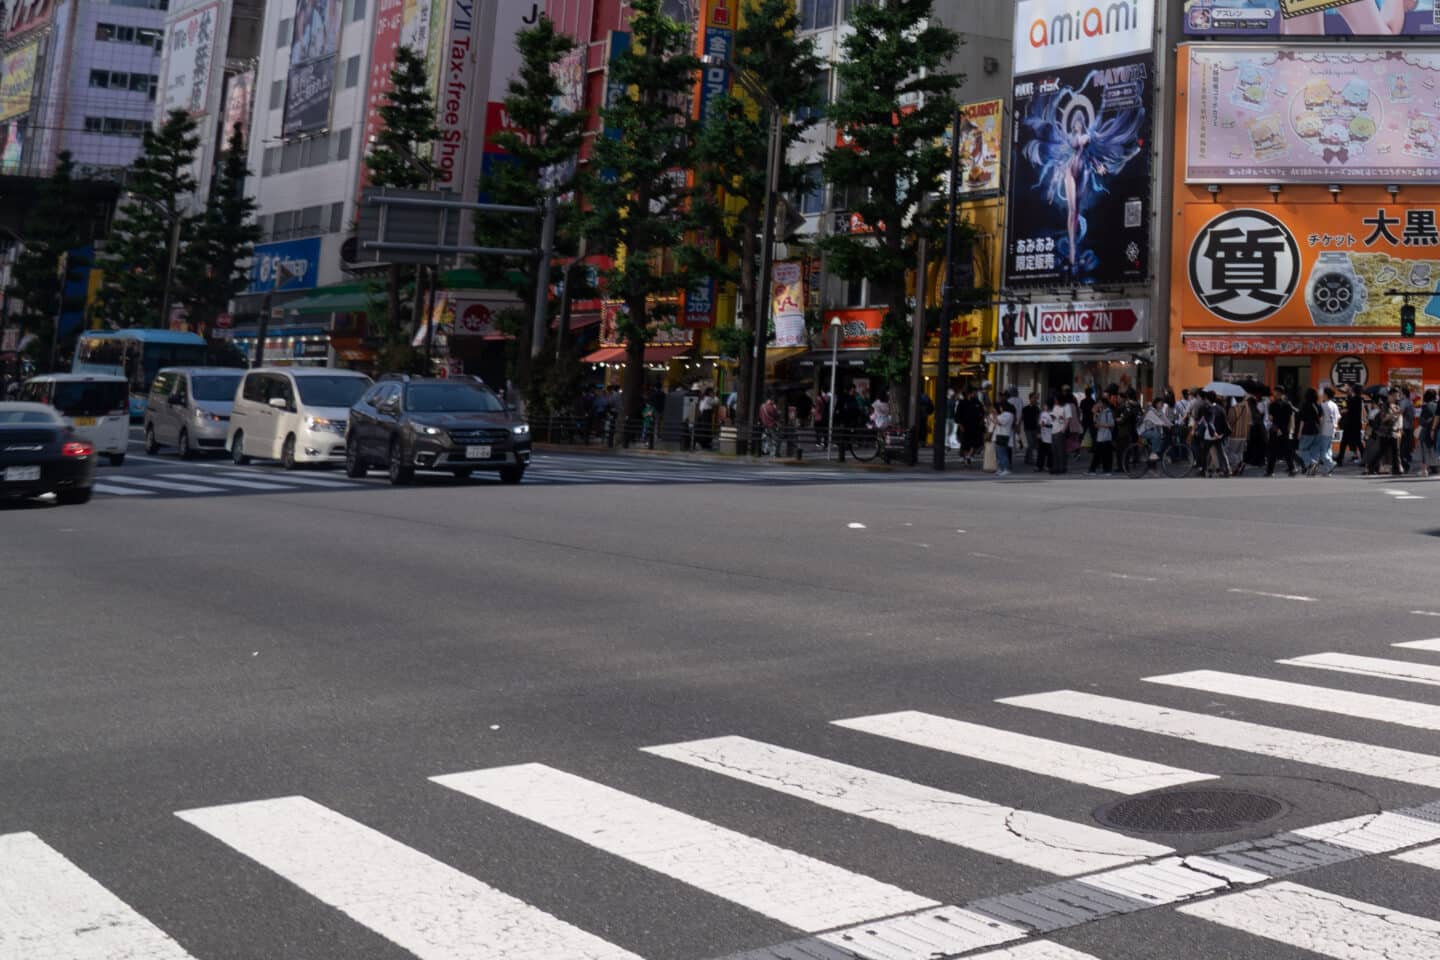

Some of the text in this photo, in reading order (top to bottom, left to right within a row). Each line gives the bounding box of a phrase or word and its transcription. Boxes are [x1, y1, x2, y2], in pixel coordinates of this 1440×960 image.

[1016, 237, 1055, 253] あみあみ
[1308, 234, 1356, 247] チケット
[271, 255, 308, 283] Smap
[1203, 225, 1288, 308] 質
[1041, 312, 1112, 332] COMIC ZIN
